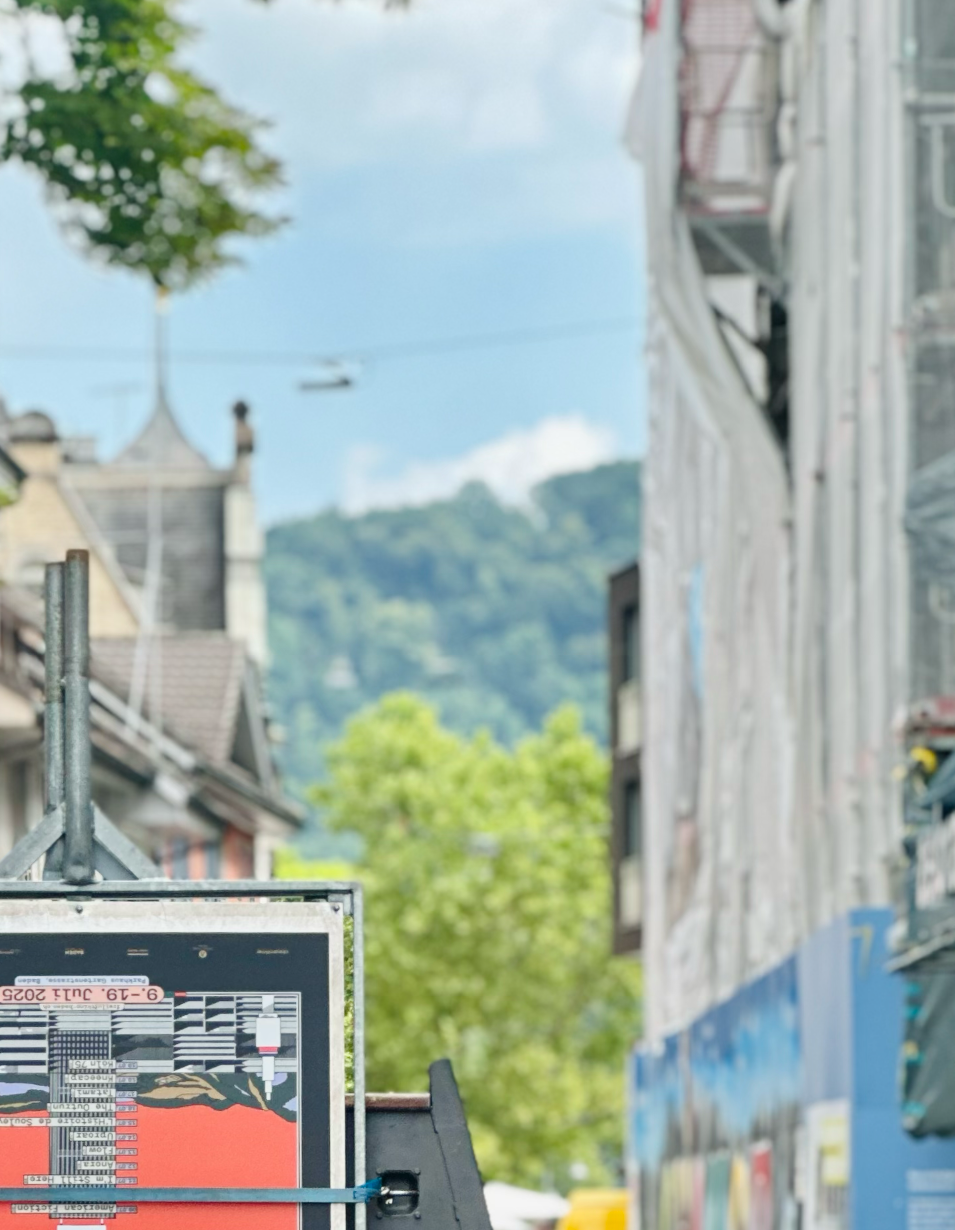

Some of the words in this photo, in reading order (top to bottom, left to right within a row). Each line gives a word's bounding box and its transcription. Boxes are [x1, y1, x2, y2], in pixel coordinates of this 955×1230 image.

[2, 988, 46, 1001] 2025
[52, 988, 93, 1001] Juli
[74, 1060, 88, 1068] 75
[90, 1060, 114, 1069] Köln
[70, 1074, 114, 1083] Kneecap
[76, 1089, 113, 1097] Tatami
[39, 1118, 52, 1126] de
[57, 1118, 114, 1126] L'Histoire
[76, 1131, 114, 1140] Uproar
[89, 1146, 114, 1154] Flow
[83, 1161, 114, 1169] Anora
[29, 1176, 54, 1184] Here
[60, 1176, 91, 1184] Still
[95, 1176, 114, 1184] I'm
[17, 1204, 58, 1213] Fiction
[64, 1204, 115, 1213] American
